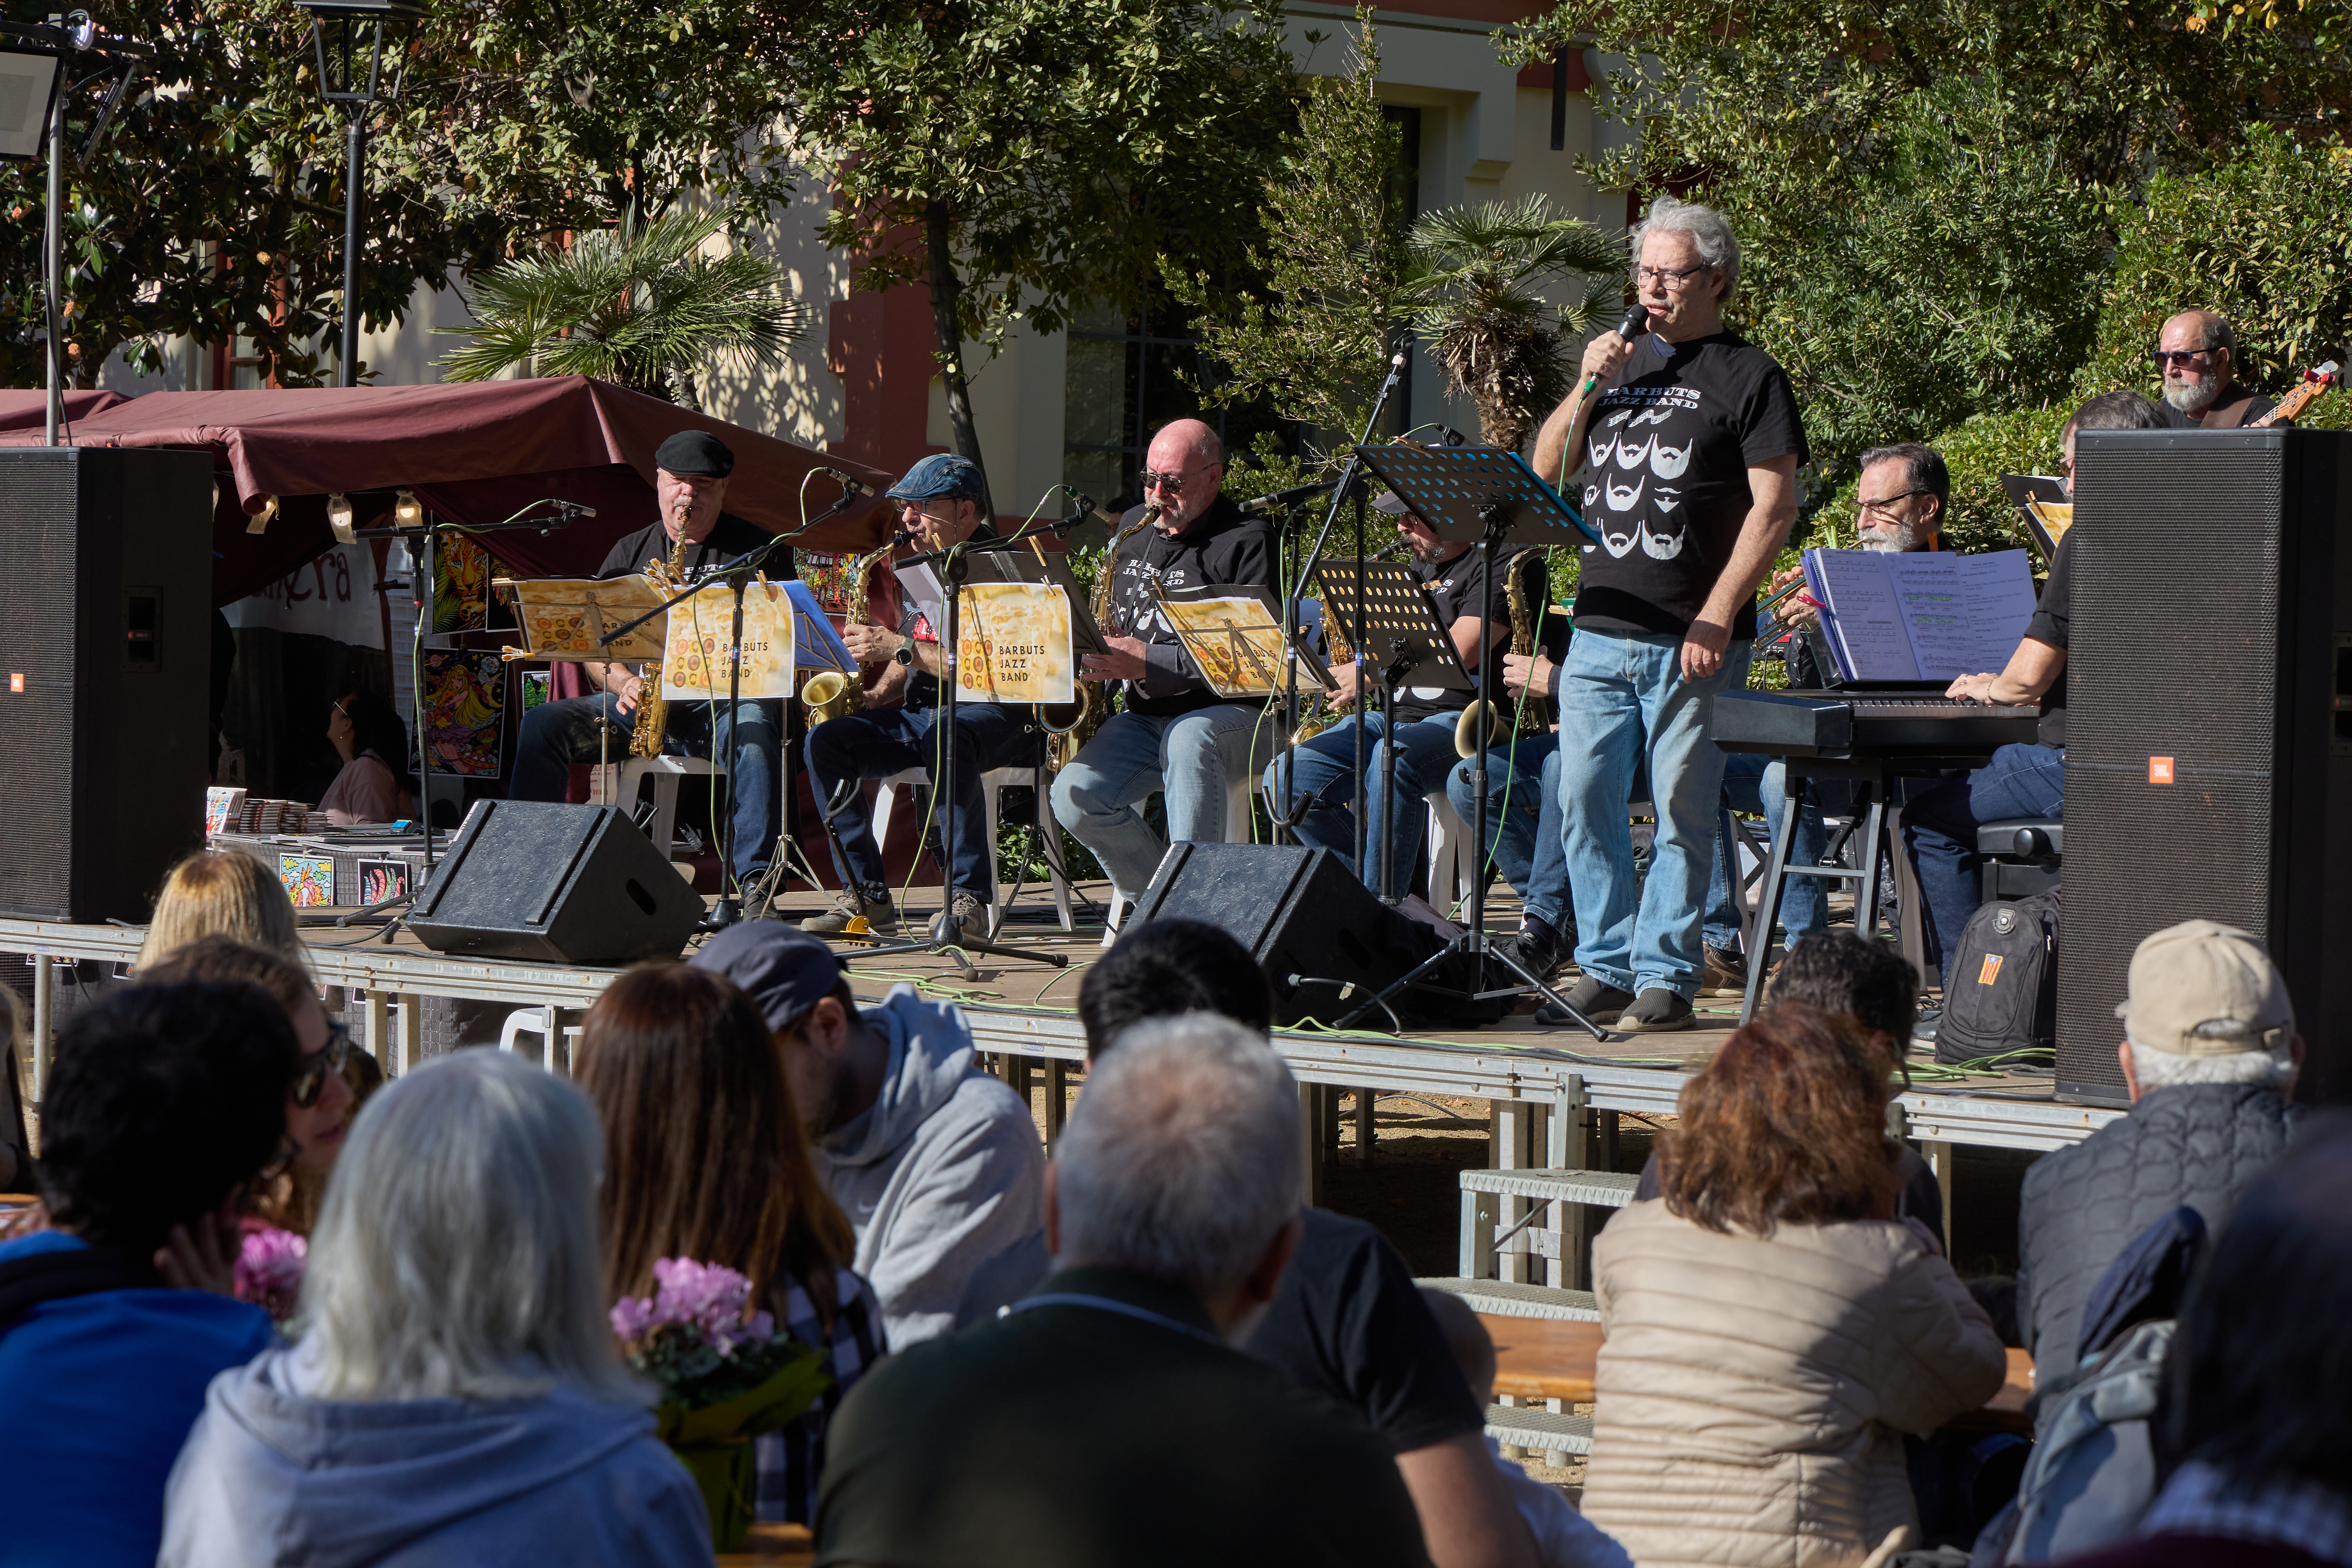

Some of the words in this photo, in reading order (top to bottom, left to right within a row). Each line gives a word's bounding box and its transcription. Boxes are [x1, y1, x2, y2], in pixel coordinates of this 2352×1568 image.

[1605, 386, 1701, 400] BARBUTS
[1598, 397, 1640, 406] JAZZ
[1643, 398, 1698, 409] BAND
[1000, 646, 1044, 654] BARBUTS
[722, 656, 748, 665] JAZ
[1000, 659, 1025, 668] JAZZ
[1001, 672, 1028, 681] BAND
[2154, 765, 2169, 776] JBL
